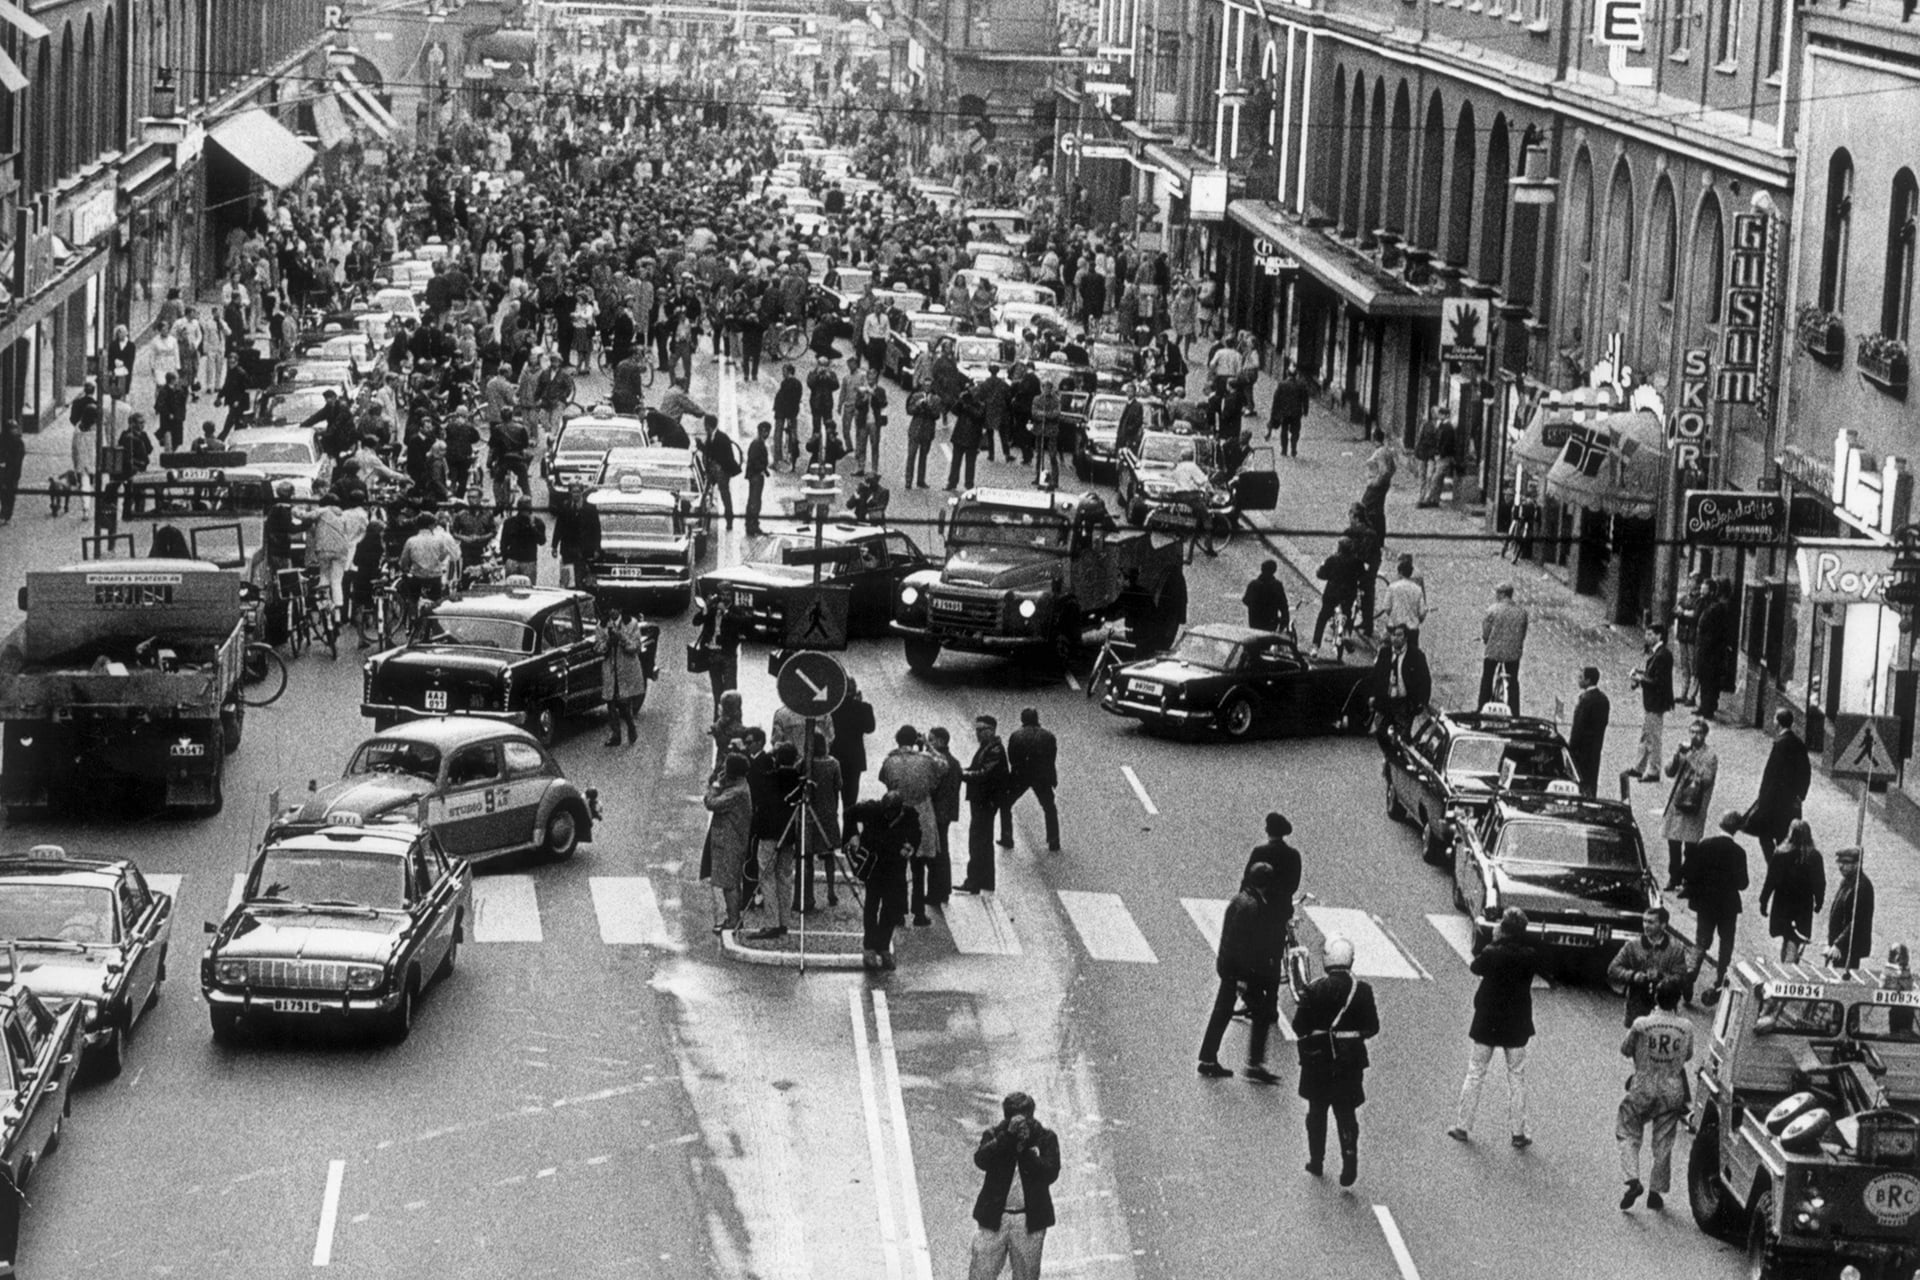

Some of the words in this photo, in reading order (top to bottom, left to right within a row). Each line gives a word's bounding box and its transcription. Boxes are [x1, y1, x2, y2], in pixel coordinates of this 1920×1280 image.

[1678, 350, 1707, 470] SKOR
[1554, 784, 1575, 792] TAXI
[449, 802, 482, 817] STUDIO
[485, 789, 495, 813] 9
[333, 815, 356, 825] TAXI
[1775, 984, 1820, 997] B10834
[1876, 1184, 1914, 1209] BRC
